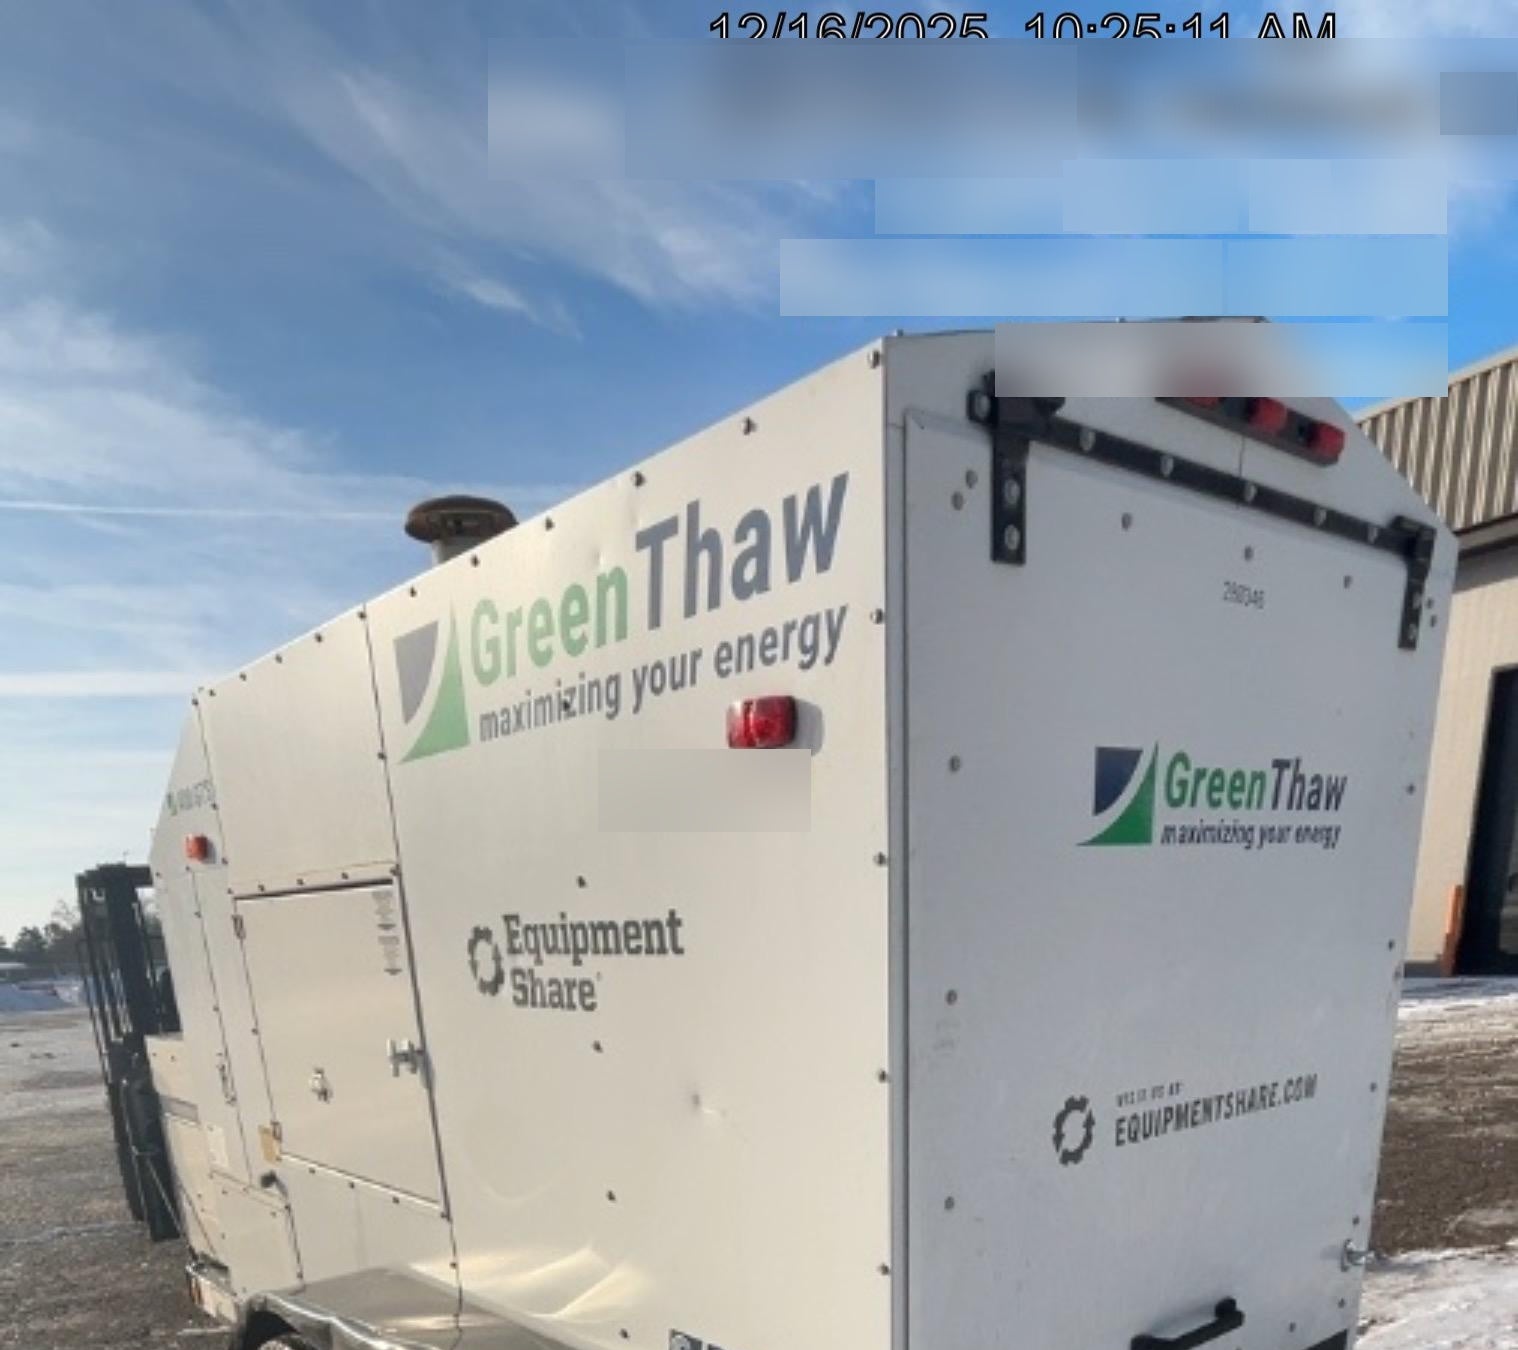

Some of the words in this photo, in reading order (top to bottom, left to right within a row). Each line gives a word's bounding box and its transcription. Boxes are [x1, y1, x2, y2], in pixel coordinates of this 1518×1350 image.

[479, 671, 621, 743] maximizing
[632, 647, 703, 714] your
[714, 604, 848, 679] energy
[1163, 750, 1348, 811] GreenThaw
[1160, 818, 1255, 850] maximizing
[1256, 824, 1292, 850] your
[1294, 824, 1342, 850] energy
[502, 908, 685, 966] Equipment
[510, 966, 598, 1011] Share
[1115, 1073, 1318, 1147] EQUIPMENTSHARE.COM
